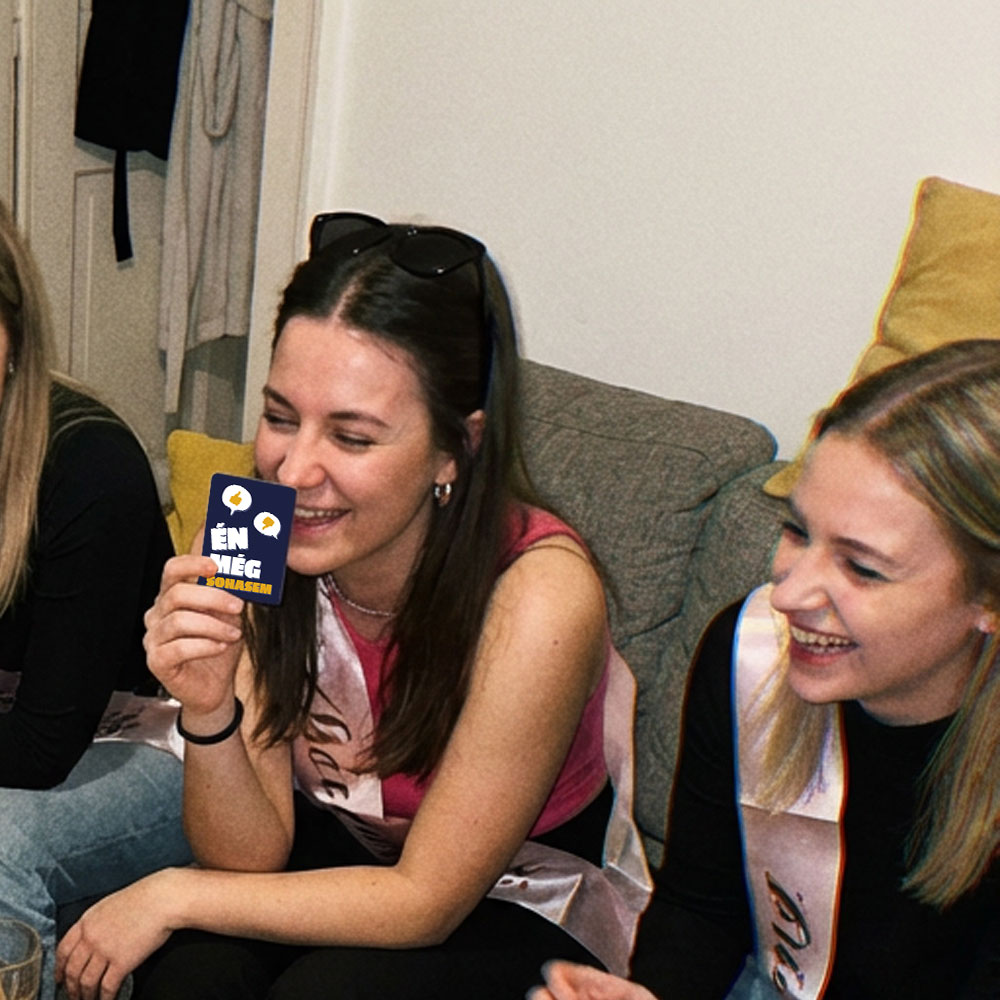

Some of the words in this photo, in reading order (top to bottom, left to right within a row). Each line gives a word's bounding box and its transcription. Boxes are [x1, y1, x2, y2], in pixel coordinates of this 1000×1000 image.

[210, 523, 248, 550] ÉN
[210, 553, 262, 579] MÉG
[206, 576, 272, 595] SOHASEM
